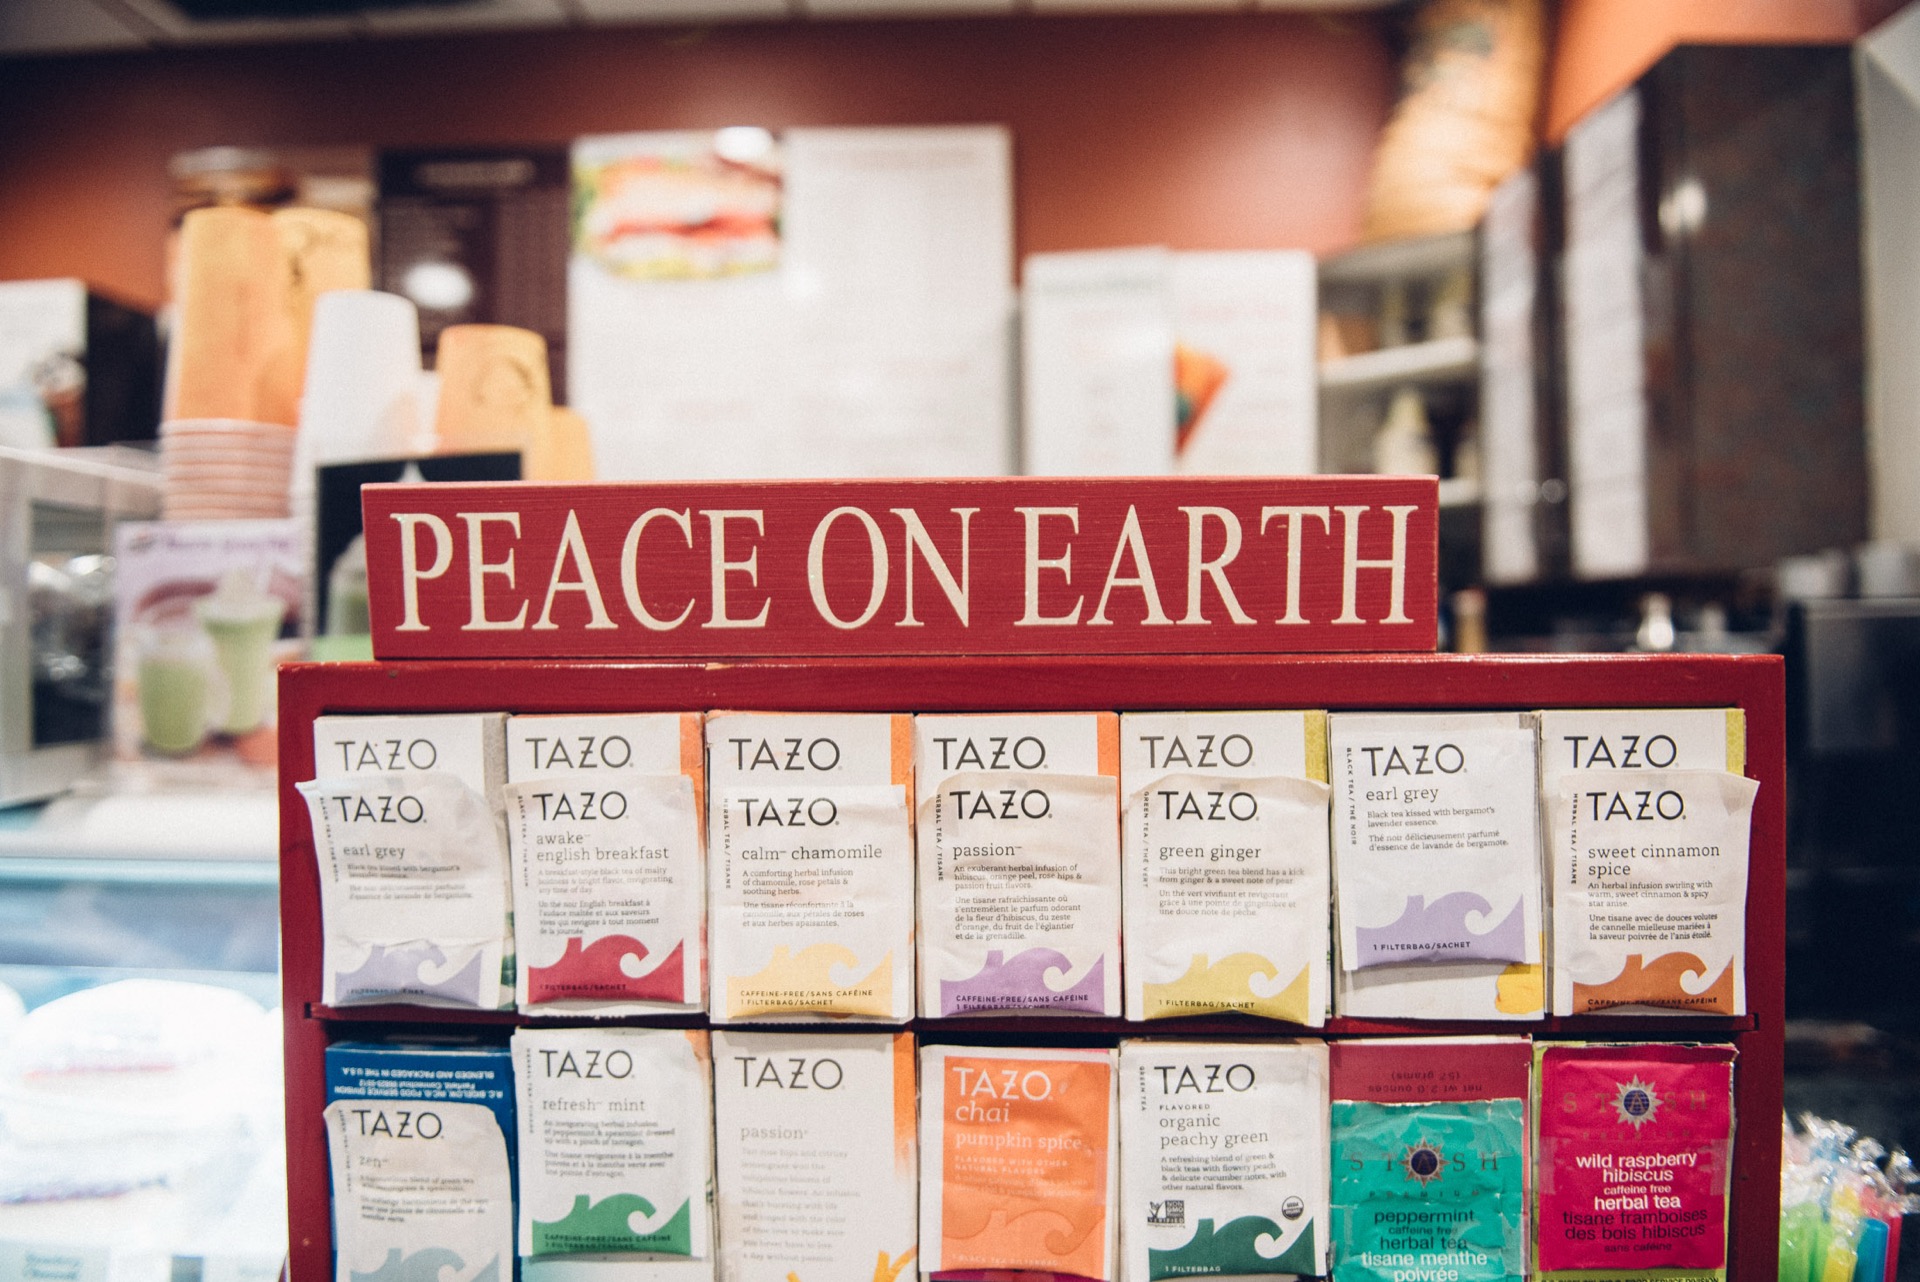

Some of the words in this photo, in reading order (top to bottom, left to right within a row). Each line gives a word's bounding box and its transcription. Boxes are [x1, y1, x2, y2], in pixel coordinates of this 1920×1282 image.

[389, 507, 771, 632] PEACE
[807, 506, 980, 631] ON
[1013, 504, 1418, 627] EARTH
[334, 738, 437, 771] TAZO
[525, 735, 632, 770] TAZO
[729, 737, 840, 771] TAZO
[932, 736, 1046, 771] TAZO
[1140, 733, 1253, 768] TAZO
[1563, 735, 1677, 768] TAZO
[1361, 744, 1465, 776] TAZO
[1366, 787, 1398, 801] earl
[1404, 788, 1439, 803] grey
[332, 796, 423, 823] TAZO
[532, 791, 627, 821] TAZO
[737, 797, 837, 826] TAZO
[950, 789, 1050, 820] TAZO
[1158, 791, 1257, 821] TAZO
[1367, 810, 1389, 818] Black
[1405, 809, 1431, 817] kissed
[1452, 807, 1495, 816] bergamot's
[1586, 790, 1684, 820] TAZO
[1368, 820, 1402, 828] lavender
[343, 844, 370, 855] earl
[375, 847, 405, 859] grey
[536, 848, 590, 865] english
[595, 846, 669, 861] breakfast
[791, 845, 883, 859] chamomile
[1159, 846, 1204, 860] green
[1211, 845, 1261, 861] ginger
[1588, 847, 1637, 859] sweet
[1642, 844, 1720, 858] cinnamon
[821, 868, 853, 876] infusion
[1588, 862, 1631, 879] spice
[817, 879, 840, 887] petals
[1266, 876, 1273, 884] of
[1665, 881, 1695, 890] swirling
[1696, 880, 1713, 888] with
[743, 888, 776, 896] soothing
[1641, 890, 1681, 898] cinnamon
[1691, 890, 1709, 899] spicy
[1020, 905, 1048, 913] parfum
[795, 920, 840, 928] apaisantes.
[1628, 932, 1657, 941] poivrée
[1659, 932, 1668, 940] de
[1670, 932, 1690, 940] l'anis
[1380, 941, 1472, 951] FILTERBAG/SACHET
[740, 989, 834, 997] CAFFEINE-FREE/SANS
[1165, 1000, 1256, 1009] FILTERBAG/SACHET
[539, 1050, 633, 1079] TAZO
[734, 1057, 843, 1090] TAZO
[1154, 1063, 1256, 1095] TAZO
[952, 1067, 1052, 1102] TAZO
[608, 1099, 646, 1111] mint
[955, 1101, 1010, 1123] chai
[352, 1110, 442, 1139] TAZO
[1159, 1114, 1221, 1131] organic
[955, 1132, 1032, 1151] pumpkin
[1038, 1135, 1082, 1153] spice
[1160, 1132, 1219, 1149] peachy
[1225, 1131, 1269, 1149] green
[1161, 1164, 1182, 1172] black
[1222, 1164, 1251, 1173] flowery
[1253, 1163, 1276, 1171] peach
[1576, 1155, 1612, 1168] wild
[1618, 1153, 1697, 1170] raspberry
[1603, 1168, 1674, 1183] hibiscus
[1604, 1184, 1647, 1195] caffeine
[1650, 1184, 1672, 1194] free
[1594, 1196, 1648, 1211] herbal
[1654, 1195, 1681, 1209] tea
[1374, 1209, 1474, 1224] peppermint
[1563, 1211, 1615, 1225] tisane
[1620, 1208, 1708, 1225] framboises
[1389, 1226, 1433, 1235] caffeine
[1437, 1226, 1458, 1235] free
[1565, 1227, 1596, 1240] des
[1602, 1226, 1637, 1240] bois
[1642, 1223, 1706, 1239] hibiscus
[1380, 1236, 1434, 1250] herbal
[1441, 1237, 1468, 1250] tea
[1604, 1244, 1629, 1253] sans
[1361, 1252, 1414, 1267] tisane
[1421, 1252, 1488, 1266] menthe
[1394, 1267, 1459, 1282] poivrée
